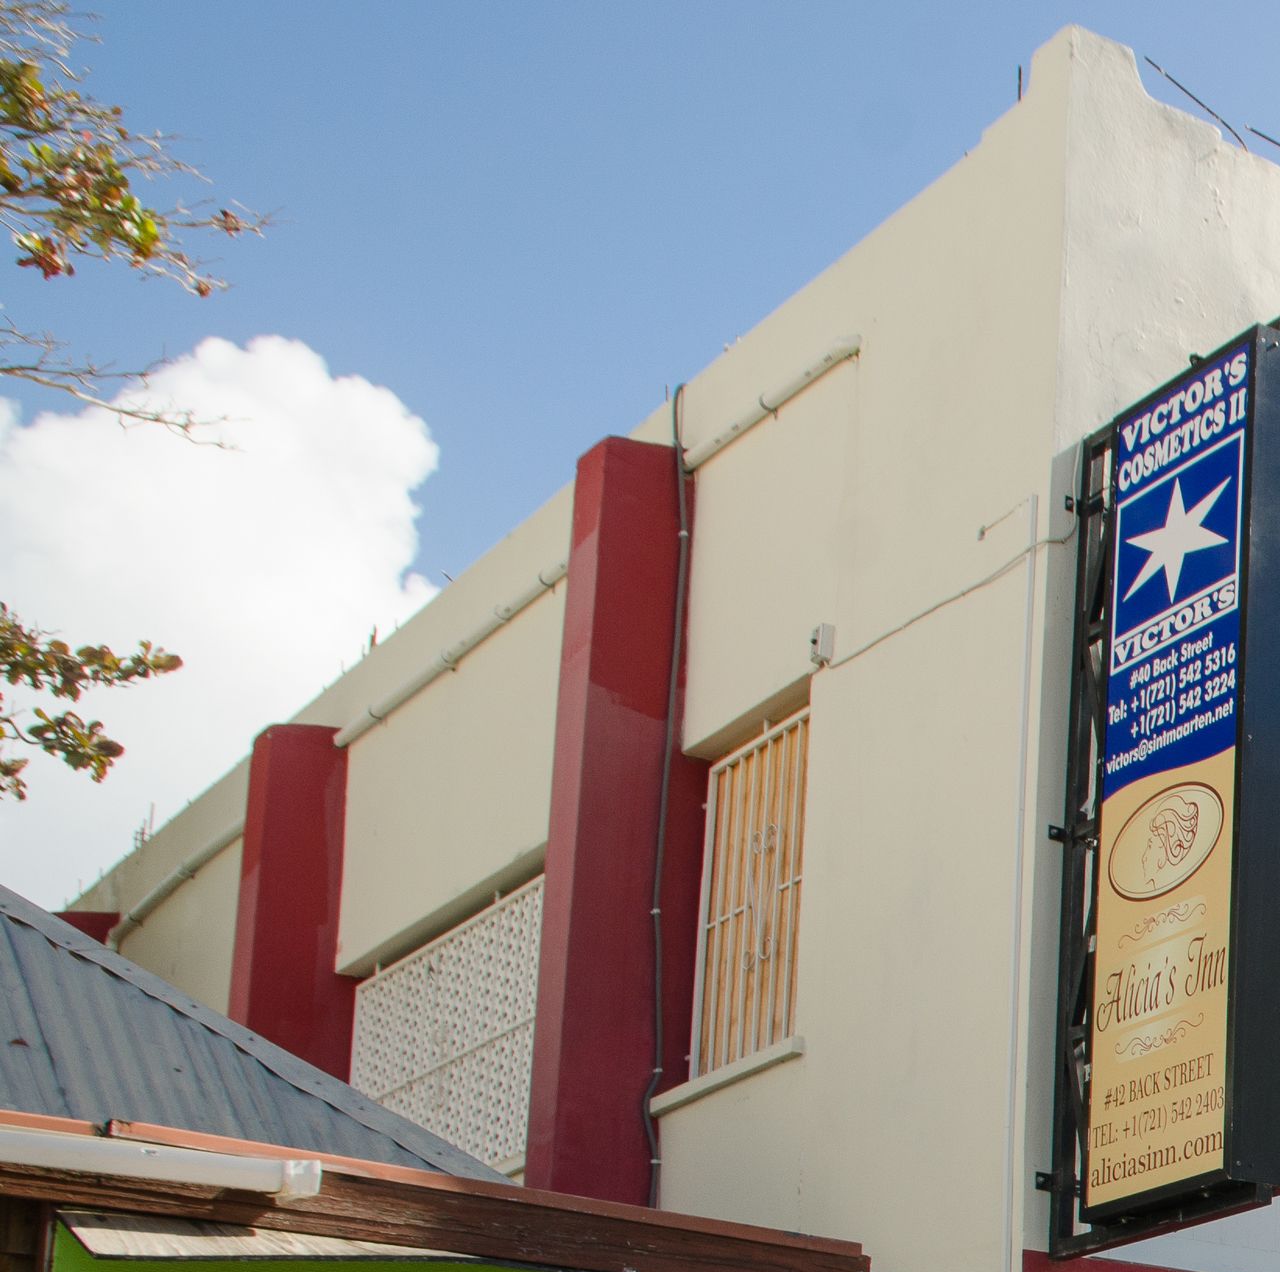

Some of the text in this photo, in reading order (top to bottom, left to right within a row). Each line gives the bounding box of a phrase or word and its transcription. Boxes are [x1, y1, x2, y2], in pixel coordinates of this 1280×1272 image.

[1118, 388, 1247, 492] COSMETICS II
[1122, 352, 1247, 453] VICTOR'S
[1114, 583, 1236, 666] VICTOR'S
[1129, 631, 1214, 690] #40 Back Street
[1108, 643, 1236, 726] Tel: +1(721) 542 5316
[1130, 673, 1236, 740] +1(721) 542 3224
[1105, 698, 1235, 775] victors@sintmaarten.net
[1096, 933, 1227, 1034] Alicia's Inn
[1092, 1086, 1225, 1150] TEL: +1(721) 542 2403
[1104, 1052, 1214, 1111] #42 BACK STREET
[1090, 1129, 1225, 1190] aliciasinn.com
